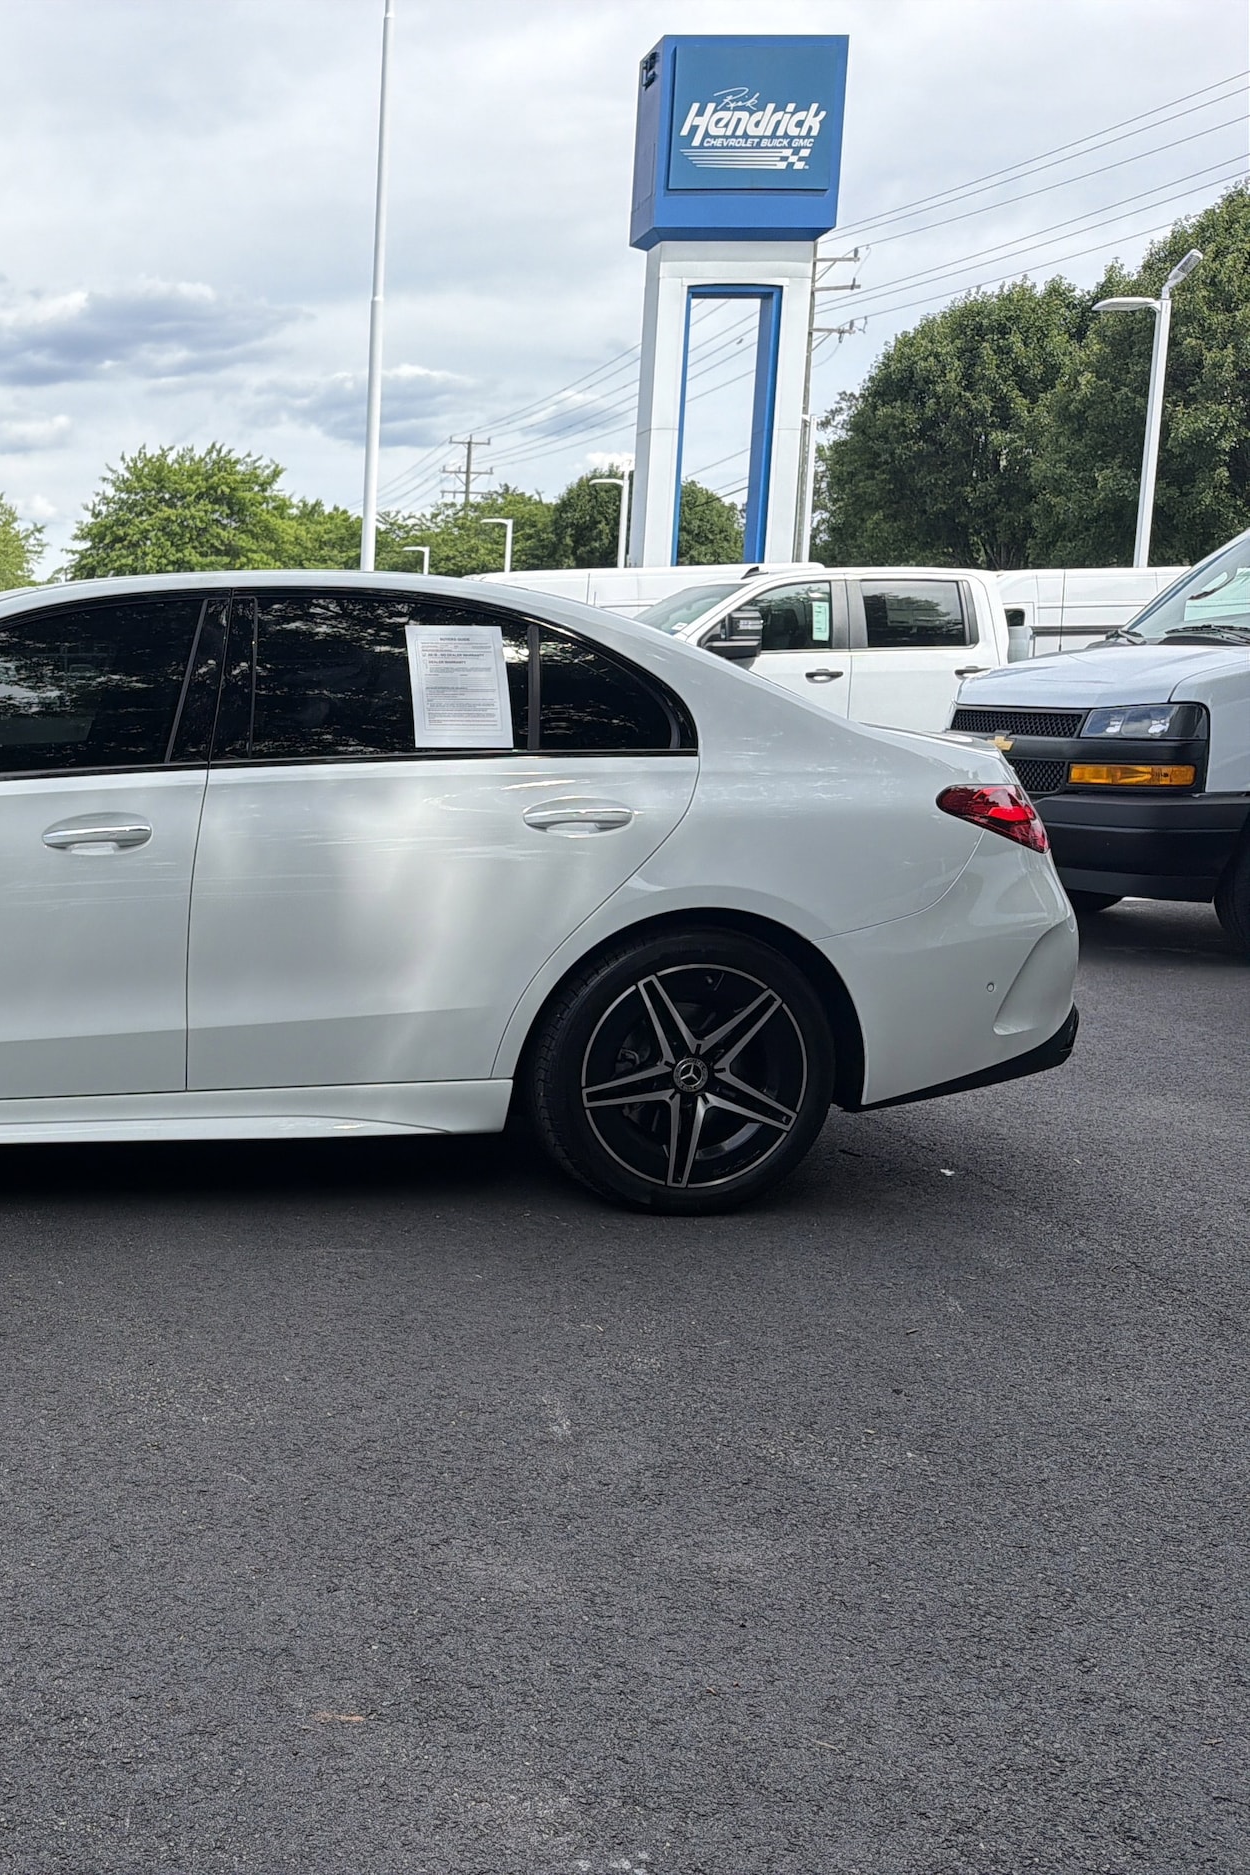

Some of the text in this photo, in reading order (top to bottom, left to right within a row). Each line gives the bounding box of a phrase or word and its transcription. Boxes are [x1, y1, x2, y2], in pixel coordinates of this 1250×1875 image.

[679, 102, 827, 146] Hendrick
[703, 138, 815, 147] CHEVROLET BUICK GMC
